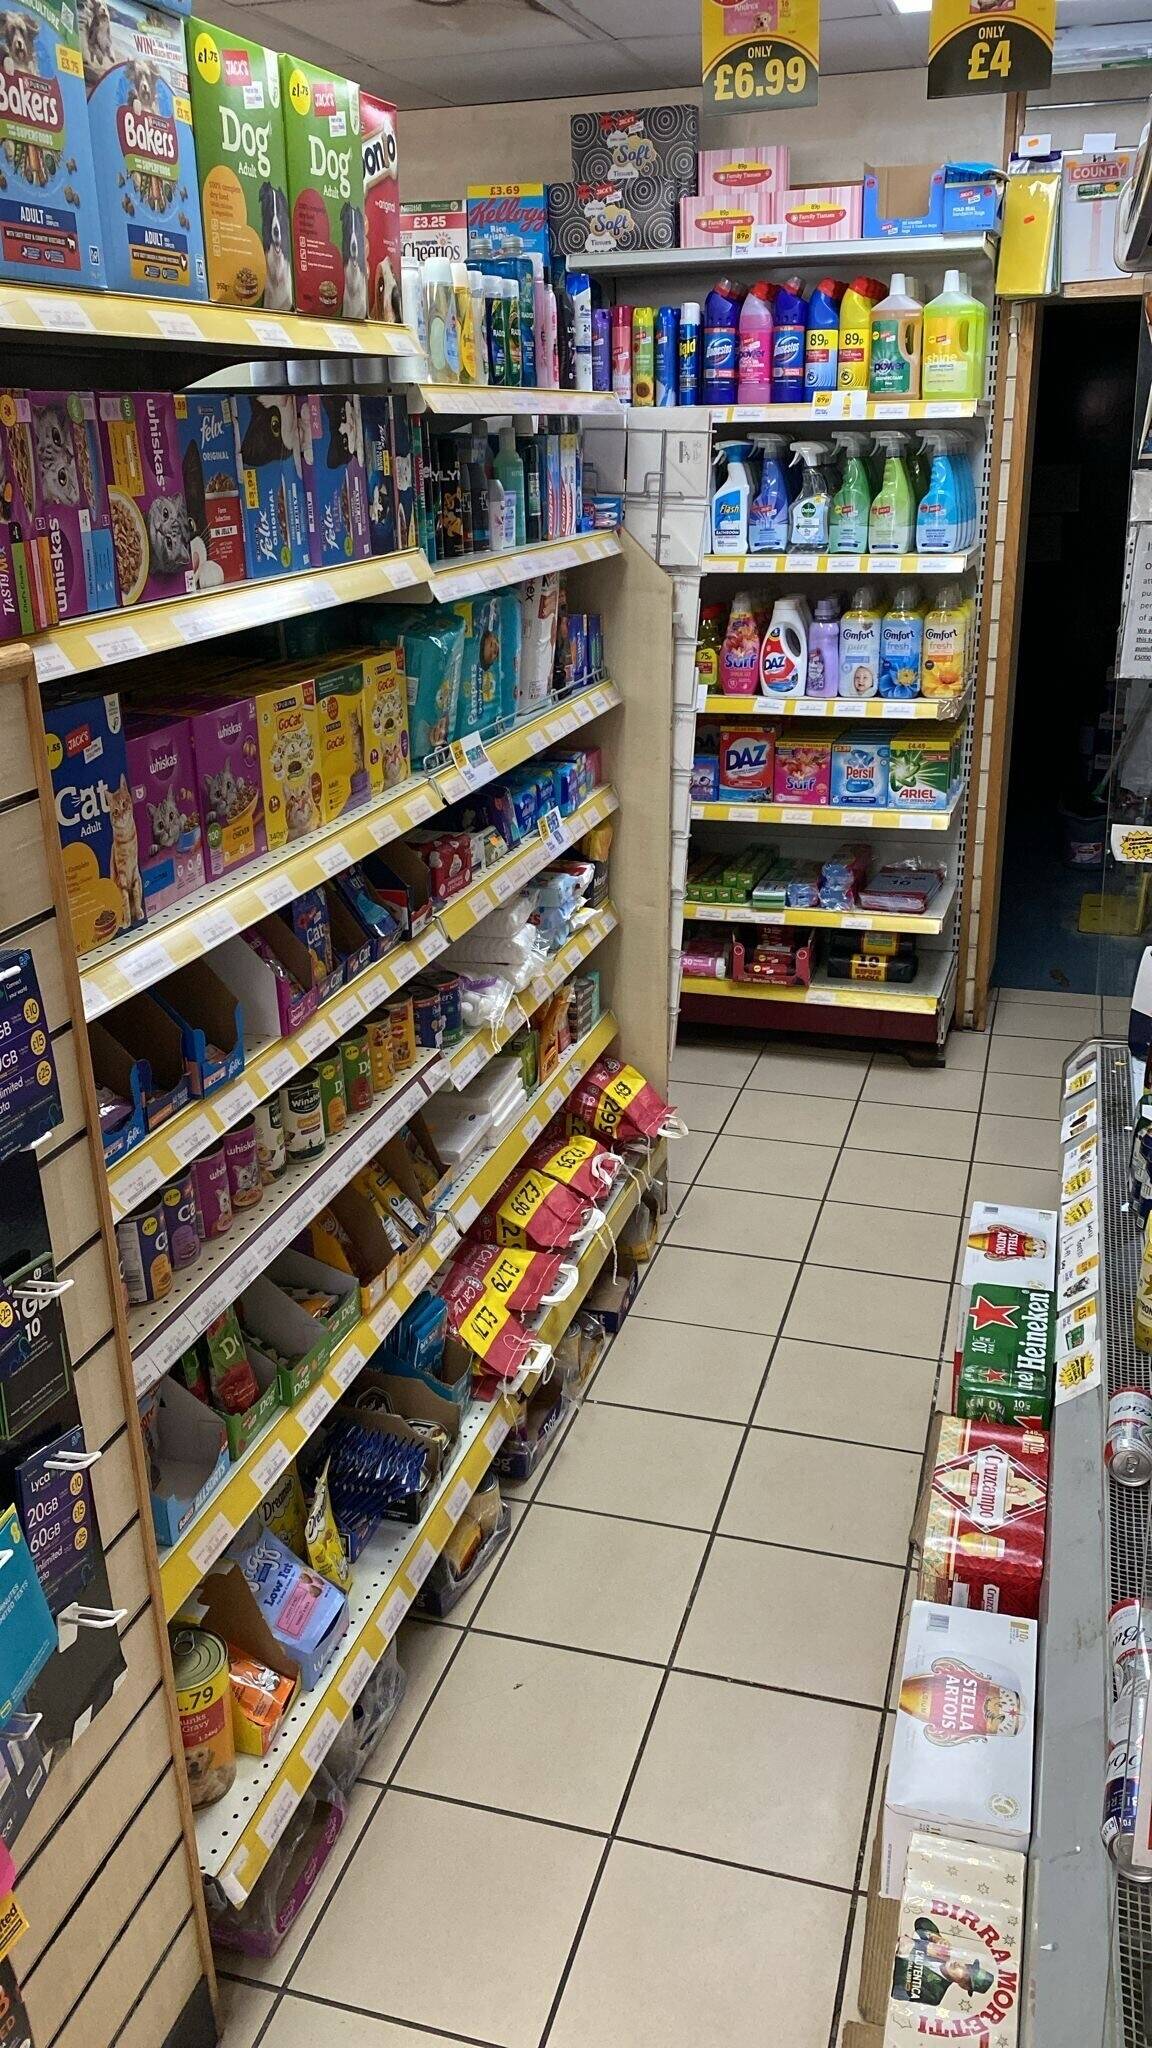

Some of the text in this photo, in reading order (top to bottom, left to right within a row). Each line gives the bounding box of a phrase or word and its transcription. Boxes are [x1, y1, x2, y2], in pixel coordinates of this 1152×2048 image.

[978, 25, 1005, 39] ONLY
[134, 34, 154, 56] WIN
[748, 45, 772, 58] ONLY
[197, 47, 218, 64] £1.75
[967, 40, 1011, 80] £4
[61, 59, 80, 75] £3.75
[225, 60, 249, 76] JACK'S
[713, 56, 806, 100] £6.99
[0, 72, 60, 126] Bakers
[291, 83, 309, 97] £1.75
[314, 93, 336, 107] JACK'S
[124, 112, 175, 159] Bakers
[219, 105, 271, 178] Dog
[617, 144, 650, 166] Soft
[238, 161, 257, 179] Adult
[308, 134, 352, 198] Dog
[1073, 162, 1125, 180] COUNTY
[323, 185, 340, 199] Adult
[490, 186, 520, 196] £3.69
[20, 206, 44, 224] ADULT
[413, 216, 446, 228] £3.25
[595, 213, 627, 236] Soft
[145, 230, 163, 246] ADULT
[736, 232, 750, 240] 89p
[403, 243, 461, 261] Cheerios
[810, 334, 829, 346] 89p
[845, 333, 864, 345] 89p
[874, 361, 905, 373] power
[927, 353, 958, 364] shine
[201, 416, 223, 449] felix
[146, 399, 165, 487] whiskas
[720, 505, 740, 514] Flash
[259, 511, 277, 562] felix
[49, 517, 68, 613] whiskas
[842, 629, 875, 641] Comfort
[883, 629, 915, 641] Comfort
[926, 628, 958, 641] Comfort
[887, 642, 909, 650] fresh
[929, 642, 953, 650] fresh
[725, 654, 757, 669] Surf
[763, 656, 785, 670] DAZ
[217, 722, 243, 740] whiskas
[278, 713, 303, 731] GoCat
[67, 730, 89, 751] JACK'S
[327, 735, 345, 751] GoCat
[150, 753, 178, 776] whiskas
[725, 744, 767, 770] DAZ
[846, 766, 874, 779] Persil
[786, 777, 816, 790] Surf
[899, 789, 936, 799] ARIEL
[55, 780, 111, 828] Cat
[80, 822, 101, 838] Adult
[307, 922, 325, 945] Cat
[511, 1180, 540, 1216] £2.99
[996, 1231, 1007, 1256] ARTOIS
[1007, 1231, 1018, 1256] STELLA
[491, 1260, 520, 1293] £1.79
[25, 1318, 41, 1341] 10
[1017, 1292, 1050, 1372] Heineken
[293, 1375, 311, 1398] Dog
[30, 1472, 51, 1493] Lyca
[980, 1455, 1003, 1518] Cruzcampo
[28, 1496, 59, 1529] 20GB
[30, 1522, 60, 1554] 60GB
[264, 1562, 294, 1607] Low Fat
[941, 1673, 961, 1731] ARTOIS
[959, 1677, 978, 1732] STELLA
[182, 1719, 210, 1734] Gravy
[917, 1899, 1018, 2038] BIRRA MORETTI
